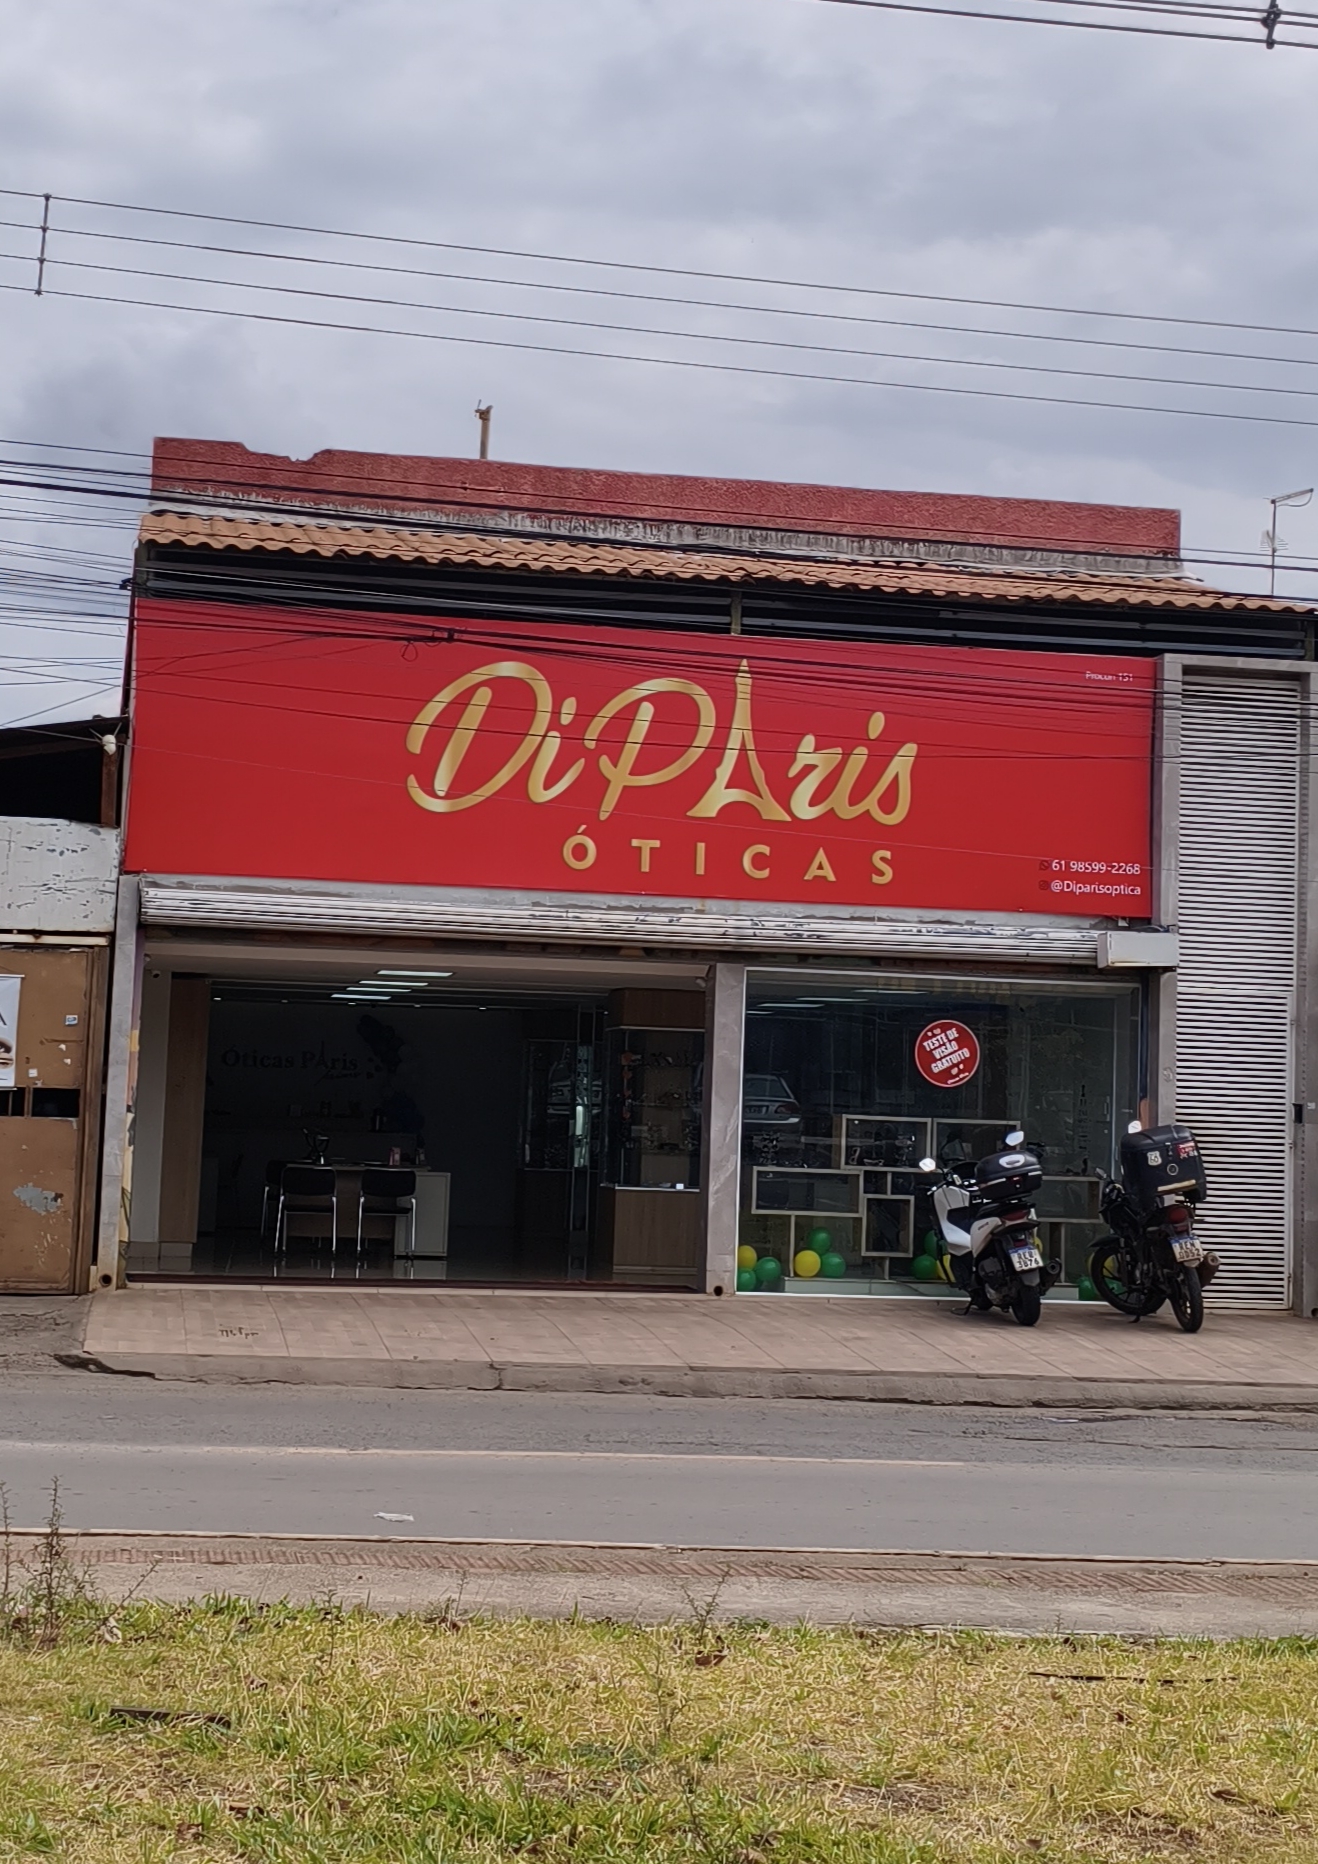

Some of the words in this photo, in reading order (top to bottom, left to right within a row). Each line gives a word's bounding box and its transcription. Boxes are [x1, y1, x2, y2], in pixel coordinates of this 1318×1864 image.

[562, 825, 893, 885] ÓTICAS
[1051, 860, 1066, 871] 61
[1069, 860, 1141, 875] 98599-2268
[1050, 880, 1141, 897] @Diparisoptica
[922, 1032, 948, 1052] TESTE
[946, 1027, 959, 1041] DE
[932, 1040, 959, 1060] VISÃO
[221, 1044, 295, 1069] Óticas
[931, 1047, 971, 1074] GRATUITO
